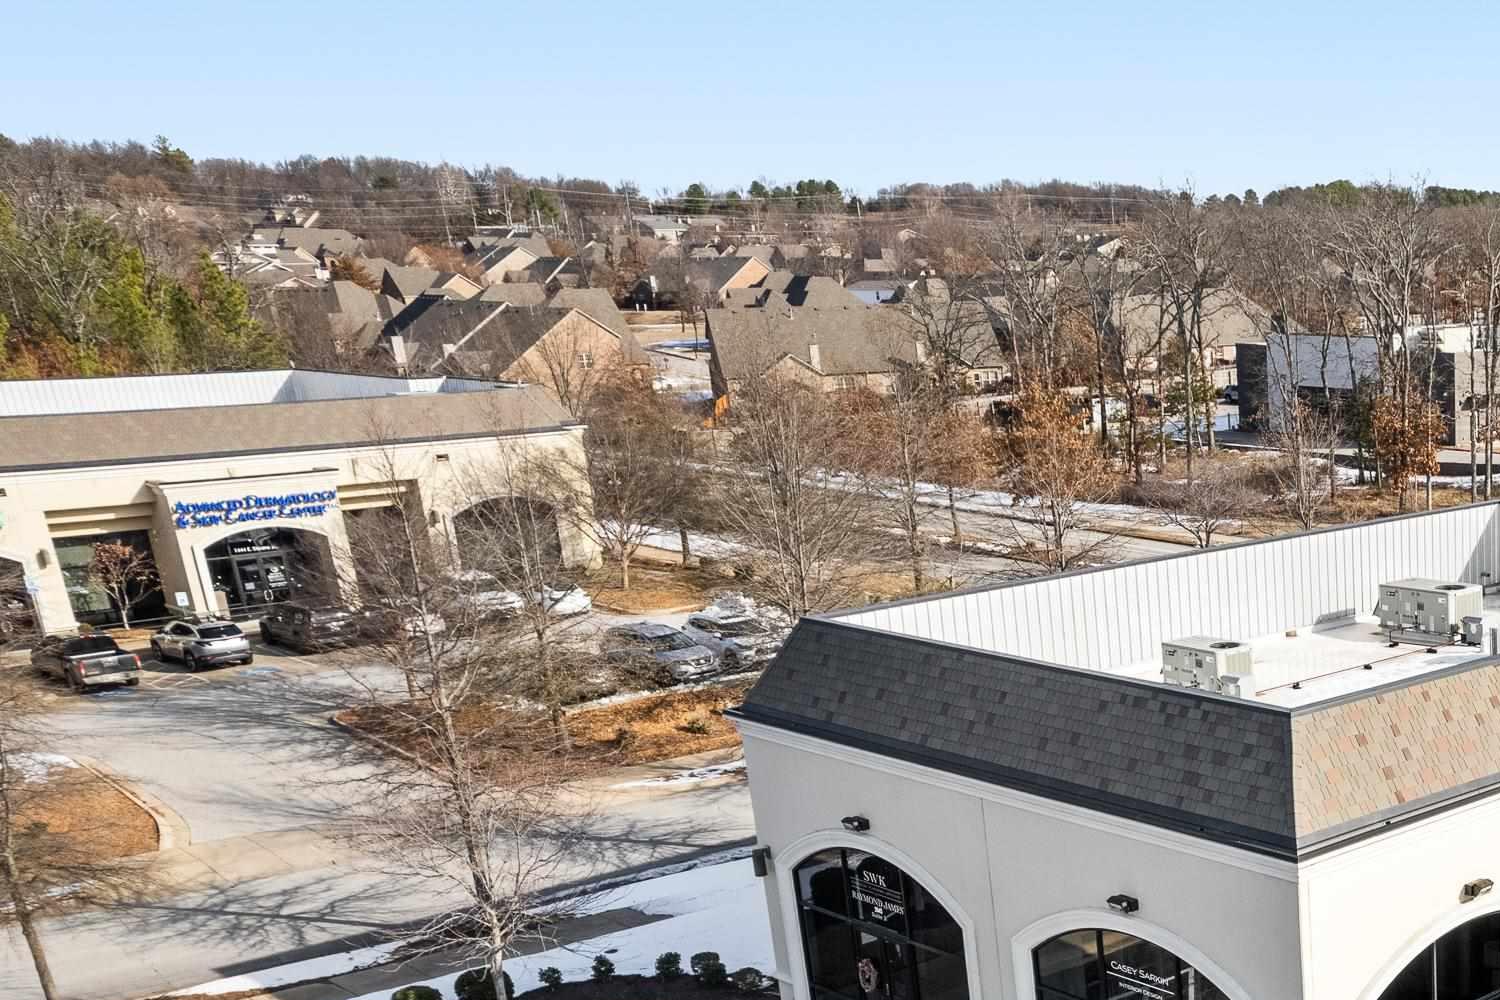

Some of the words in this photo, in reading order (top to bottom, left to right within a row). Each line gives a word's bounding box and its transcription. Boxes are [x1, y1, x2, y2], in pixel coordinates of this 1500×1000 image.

[175, 499, 243, 514] ADVANCED
[244, 489, 337, 510] DERMATOLOGY
[190, 513, 222, 528] SKIN
[224, 508, 277, 525] CANCER
[278, 504, 326, 520] CENTER
[864, 870, 887, 888] SWK
[852, 890, 883, 907] RAYMOND
[883, 901, 904, 915] JAMES
[1111, 960, 1138, 976] CASEY
[1138, 969, 1169, 987] SARKIN
